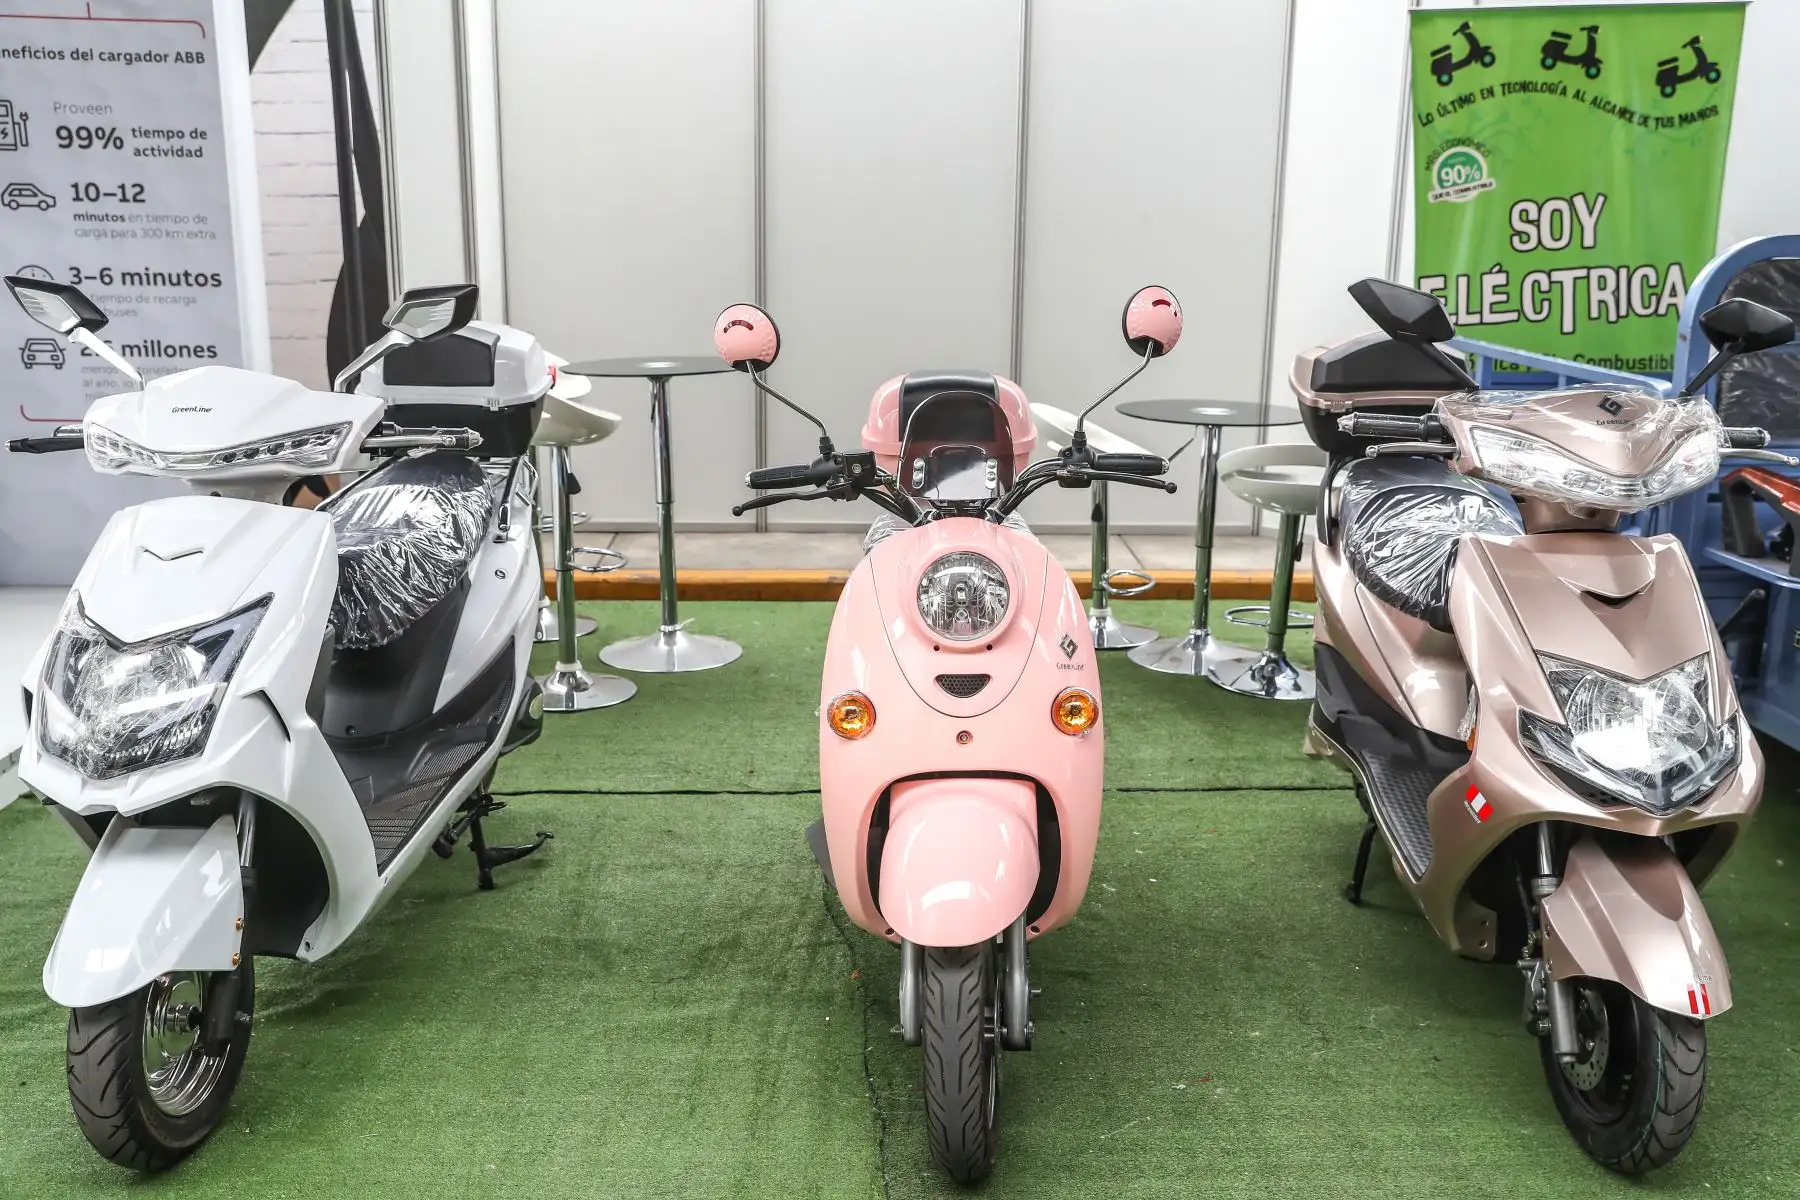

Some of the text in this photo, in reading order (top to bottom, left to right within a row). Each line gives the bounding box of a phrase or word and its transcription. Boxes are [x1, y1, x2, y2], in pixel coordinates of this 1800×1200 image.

[0, 45, 206, 66] neficios del cargador ABB
[53, 101, 113, 116] Proveen
[1480, 85, 1495, 100] EN
[1572, 88, 1587, 103] AL
[1653, 115, 1675, 131] TUS
[1678, 105, 1720, 127] MANOS
[56, 125, 124, 150] 99%
[131, 127, 208, 143] tiempo de
[133, 146, 204, 158] actividad
[1440, 163, 1482, 188] 90%
[73, 211, 208, 225] minutos en tiempo de
[1509, 192, 1607, 253] SOY
[74, 228, 217, 240] carga para 300 km extra
[121, 267, 223, 288] minutos
[135, 293, 152, 304] de
[154, 296, 197, 306] recarga
[1418, 262, 1688, 335] ELÉCTRICA
[121, 339, 218, 359] millones
[1573, 353, 1675, 371] Combustibl
